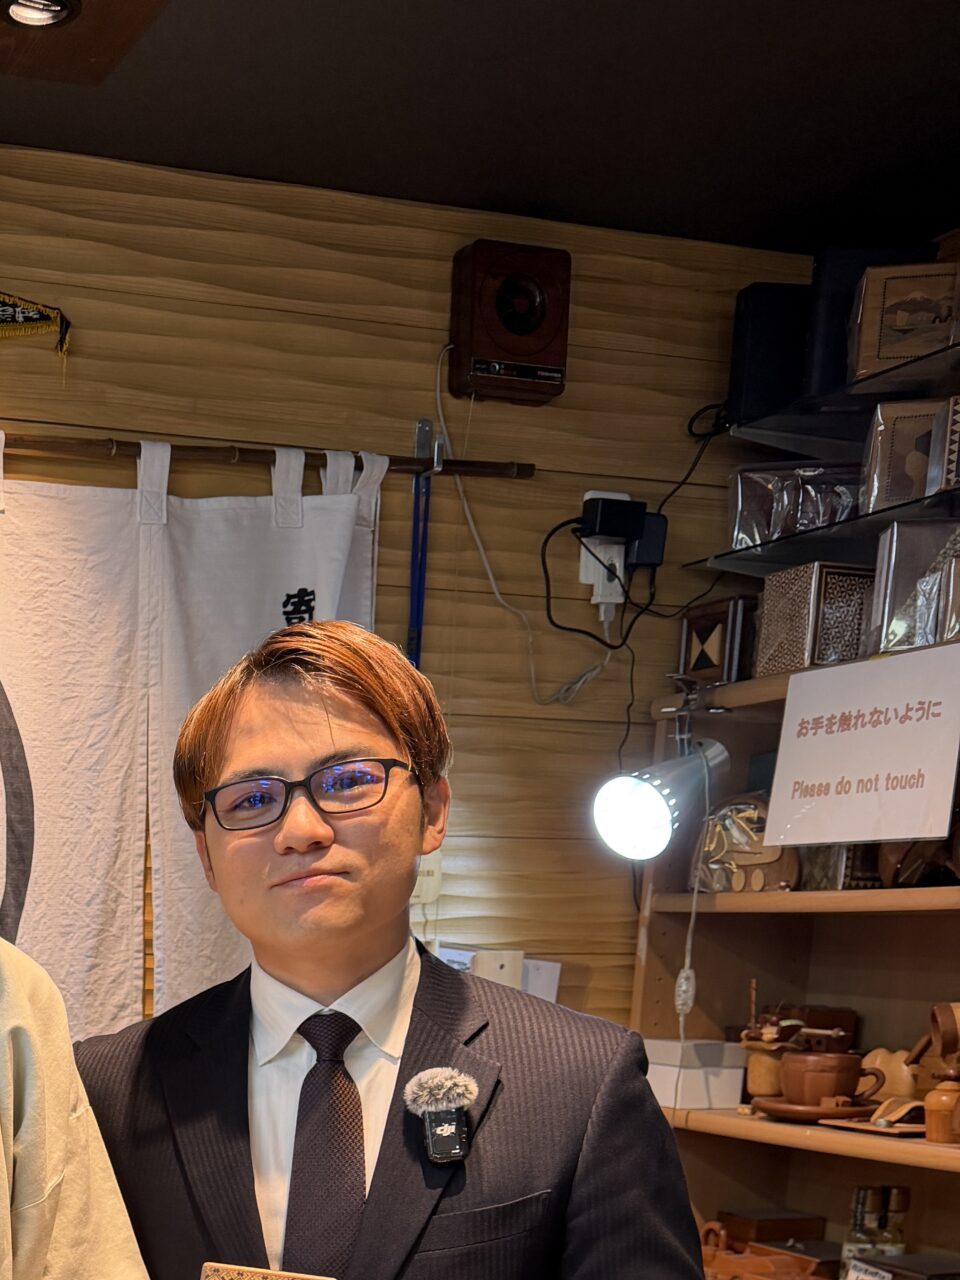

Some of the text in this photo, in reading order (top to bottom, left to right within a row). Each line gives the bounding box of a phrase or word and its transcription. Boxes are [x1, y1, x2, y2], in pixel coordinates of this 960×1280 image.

[796, 700, 942, 739] お手を触れないように
[792, 768, 926, 800] Please do not touch
